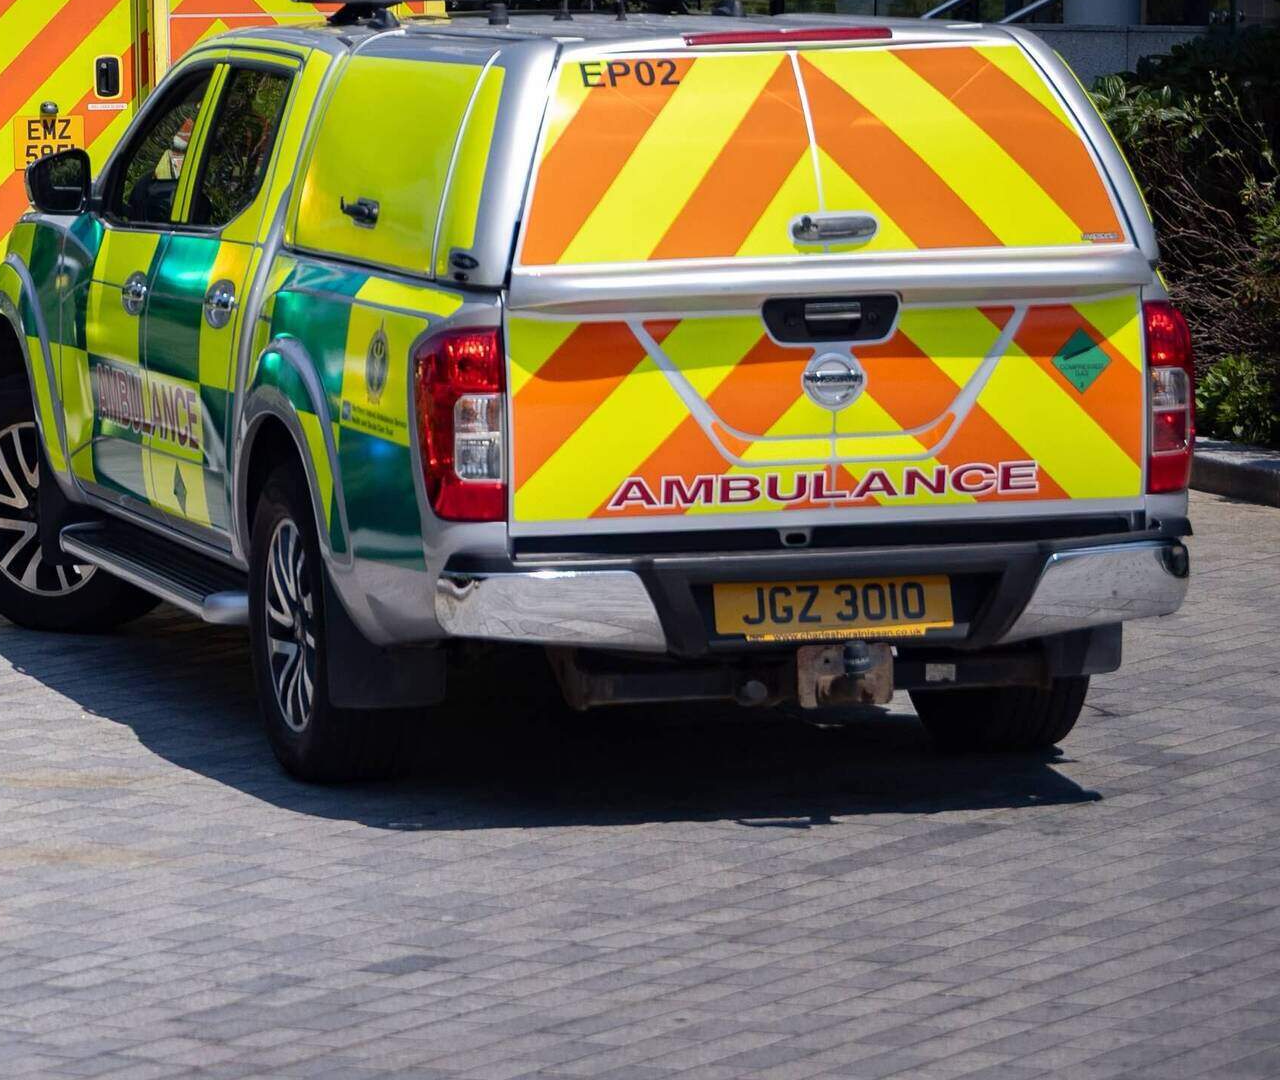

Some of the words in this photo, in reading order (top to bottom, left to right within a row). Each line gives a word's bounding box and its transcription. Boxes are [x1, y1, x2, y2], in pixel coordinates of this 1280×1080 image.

[579, 59, 680, 87] EP02
[27, 119, 71, 140] EMZ
[96, 363, 200, 452] AMBULANCE
[607, 460, 1039, 510] AMBULANCE
[742, 584, 822, 625] JGZ
[833, 581, 926, 621] 3010
